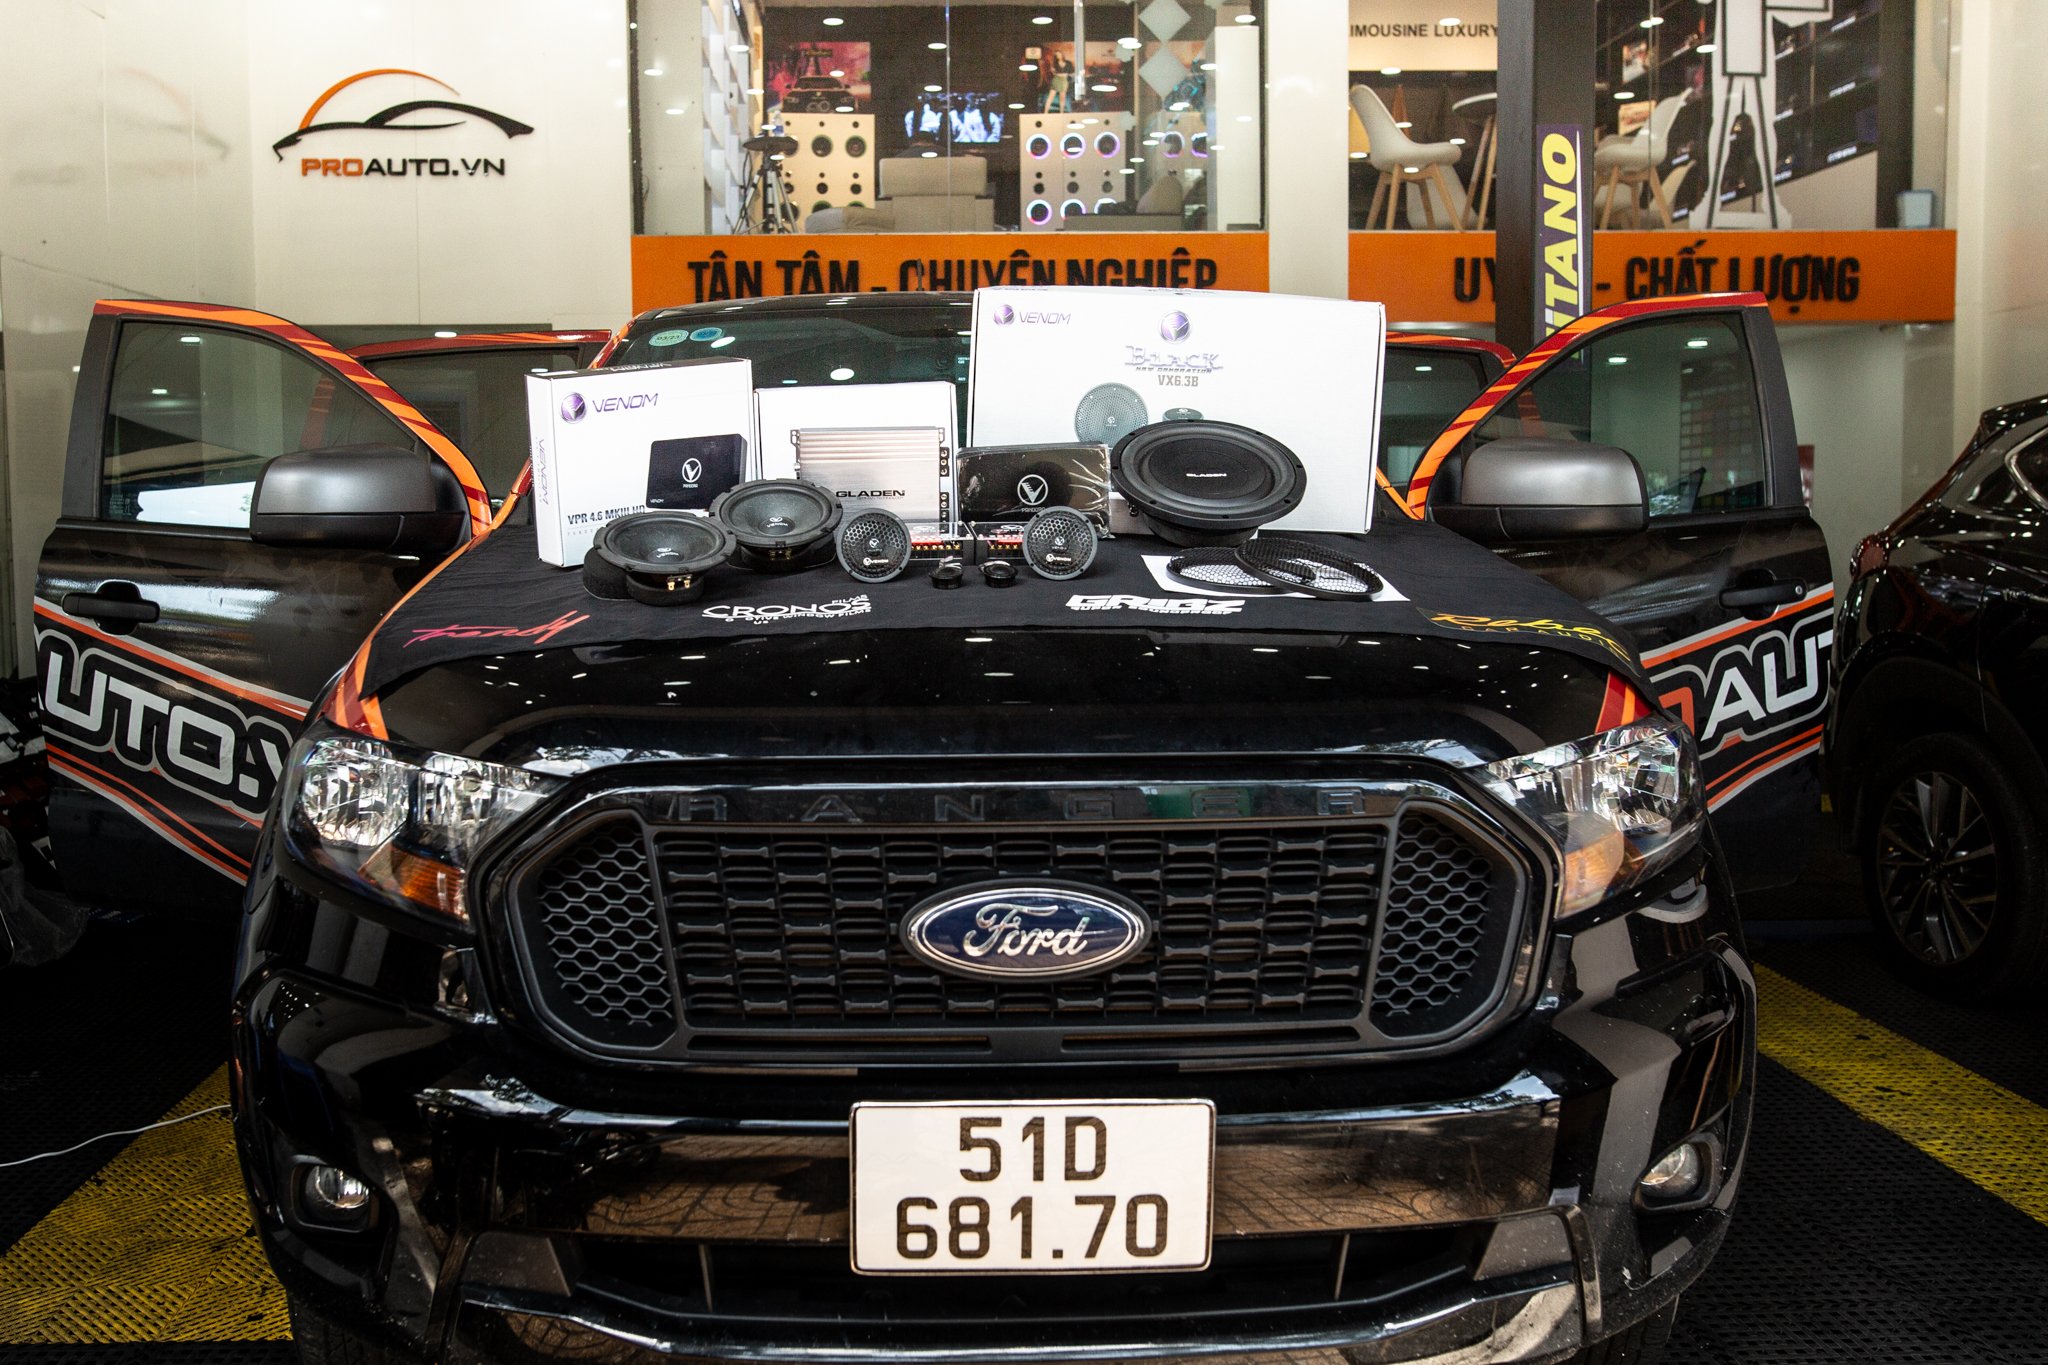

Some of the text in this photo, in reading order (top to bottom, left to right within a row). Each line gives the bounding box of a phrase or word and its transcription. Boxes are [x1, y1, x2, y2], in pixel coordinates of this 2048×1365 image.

[1348, 24, 1498, 37] IMOUSINE LUXURY
[301, 158, 505, 177] PROAUTO.VN
[688, 250, 762, 303] TÂN
[776, 250, 859, 296] TÂM
[1626, 240, 1718, 299] CHẤT
[1018, 311, 1072, 325] VENOM
[1158, 374, 1199, 388] VX6.3B
[591, 392, 659, 413] VENOM
[835, 490, 906, 498] GLADEN
[567, 513, 588, 525] VPR
[702, 599, 872, 619] CRONOS
[962, 902, 1089, 957] Ford
[959, 1116, 1107, 1182] 51D
[896, 1194, 1169, 1260] 681.70
